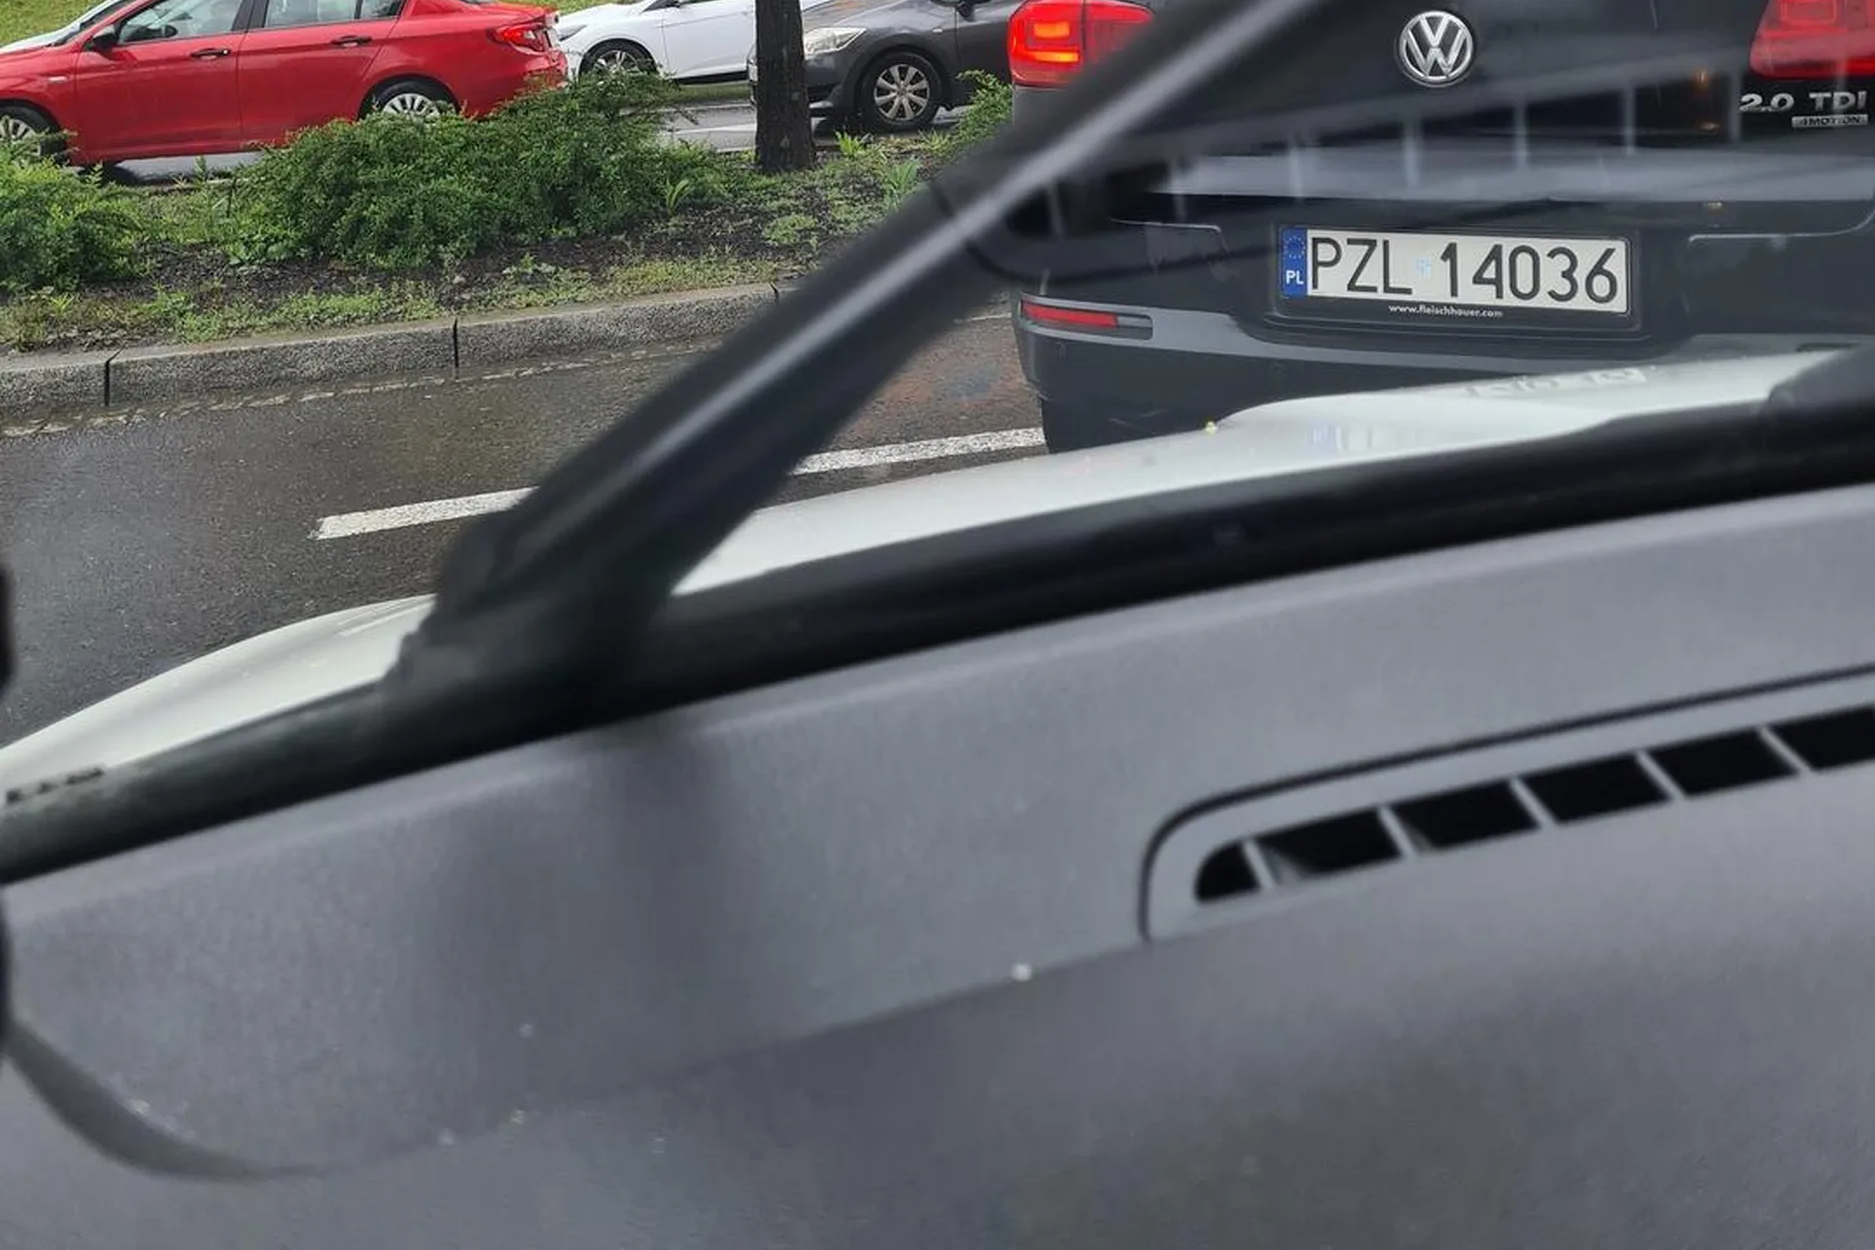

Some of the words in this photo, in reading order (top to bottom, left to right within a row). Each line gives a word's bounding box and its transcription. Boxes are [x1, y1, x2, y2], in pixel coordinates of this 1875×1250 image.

[1402, 12, 1471, 80] VW
[1739, 93, 1794, 112] 2.0
[1809, 91, 1868, 112] TDI
[1285, 269, 1304, 285] PL
[1311, 236, 1413, 296] PZL
[1440, 241, 1619, 304] 14036
